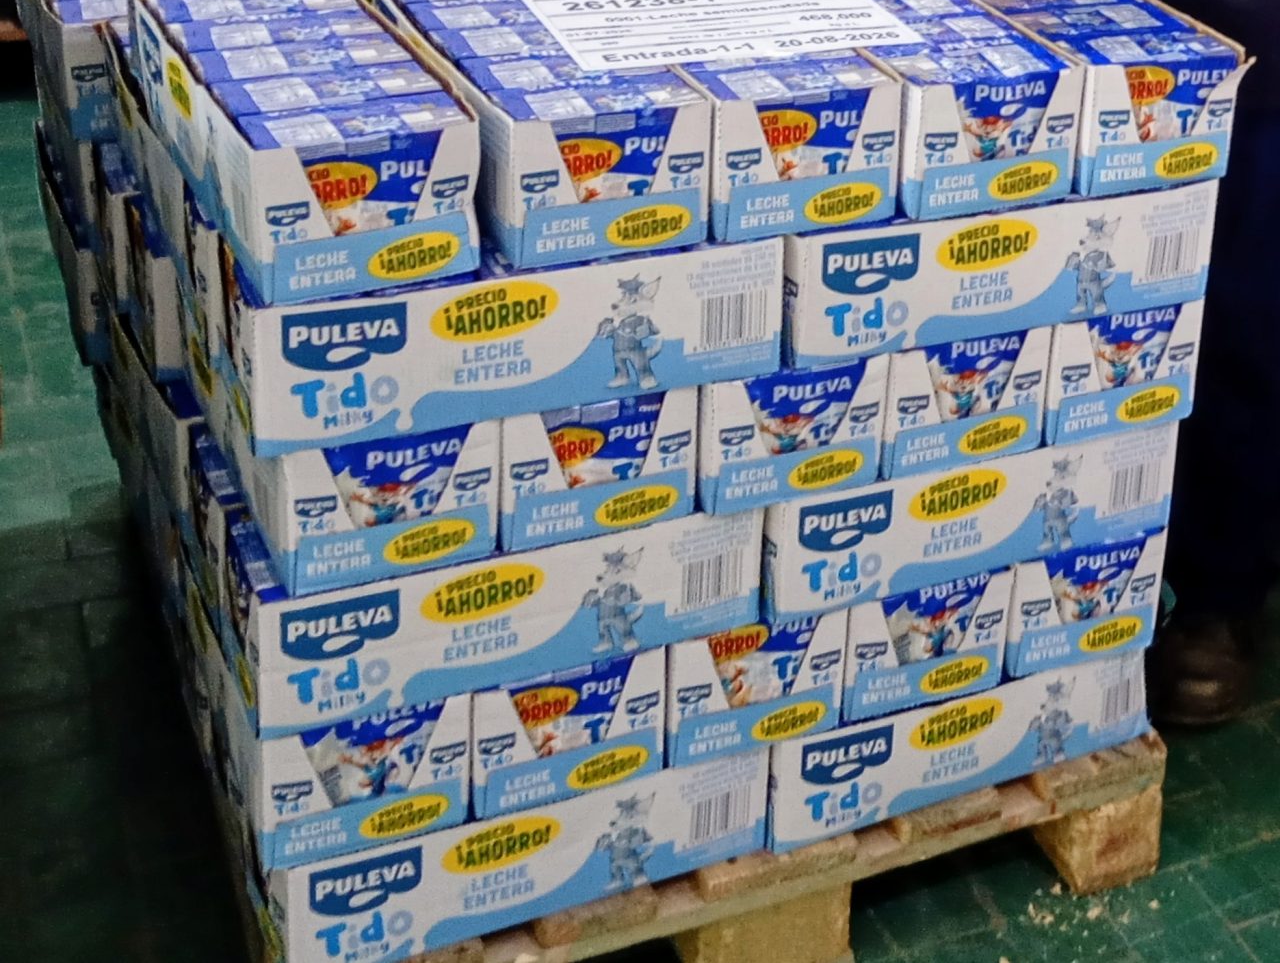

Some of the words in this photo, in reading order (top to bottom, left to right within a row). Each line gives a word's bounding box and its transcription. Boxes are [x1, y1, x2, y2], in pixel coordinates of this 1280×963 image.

[602, 42, 755, 63] Entrada-1-1
[974, 80, 1047, 102] PULEVA
[1105, 152, 1145, 167] LECHE
[1169, 147, 1195, 160] PRECIO
[935, 174, 976, 189] LECHE
[1003, 165, 1032, 180] PRECIO
[1099, 166, 1146, 182] ENTERA
[747, 194, 790, 211] LECHE
[820, 187, 852, 202] PRECIO
[929, 188, 979, 207] ENTERA
[543, 217, 590, 235] LECHE
[623, 209, 657, 225] PRECIO
[741, 209, 795, 229] ENTERA
[958, 224, 999, 241] PRECIO
[386, 238, 424, 256] PRECIO
[536, 233, 596, 254] ENTERA
[295, 249, 348, 272] LECHE
[827, 247, 914, 274] PULEVA
[289, 267, 356, 291] ENTERA
[960, 271, 1009, 292] LECHE
[455, 288, 507, 311] PRECIO
[951, 286, 1014, 311] ENTERA
[1110, 306, 1177, 329] PULEVA
[288, 318, 400, 349] PULEVA
[462, 340, 524, 364] LECHE
[950, 335, 1021, 359] PULEVA
[453, 361, 532, 385] ENTERA
[772, 375, 852, 403] PULEVA
[1069, 400, 1106, 417] LECHE
[323, 410, 373, 430] Milky
[1064, 412, 1108, 432] ENTERA
[906, 433, 945, 450] LECHE
[366, 437, 461, 470] PULEVA
[901, 446, 949, 465] ENTERA
[731, 466, 775, 484] LECHE
[928, 476, 969, 494] PRECIO
[725, 479, 778, 498] ENTERA
[532, 500, 580, 518] LECHE
[804, 503, 886, 536] PULEVA
[526, 515, 585, 537] ENTERA
[931, 518, 979, 539] LECHE
[313, 538, 365, 558] LECHE
[922, 533, 983, 558] ENTERA
[306, 554, 371, 577] ENTERA
[1075, 548, 1141, 571] PULEVA
[445, 570, 497, 592] PRECIO
[919, 573, 990, 601] PULEVA
[287, 604, 393, 643] PULEVA
[451, 616, 512, 640] LECHE
[442, 635, 518, 663] ENTERA
[1030, 631, 1068, 648] LECHE
[1026, 645, 1070, 664] ENTERA
[867, 673, 907, 691] LECHE
[862, 686, 911, 705] ENTERA
[927, 705, 968, 723] PRECIO
[694, 722, 737, 739] LECHE
[689, 733, 743, 755] ENTERA
[806, 736, 888, 772] PULEVA
[929, 744, 976, 766] LECHE
[504, 771, 550, 790] LECHE
[921, 757, 979, 783] ENTERA
[499, 785, 555, 807] ENTERA
[315, 860, 417, 903] PULEVA
[470, 864, 528, 891] LECHE
[463, 879, 534, 910] ENTERA
